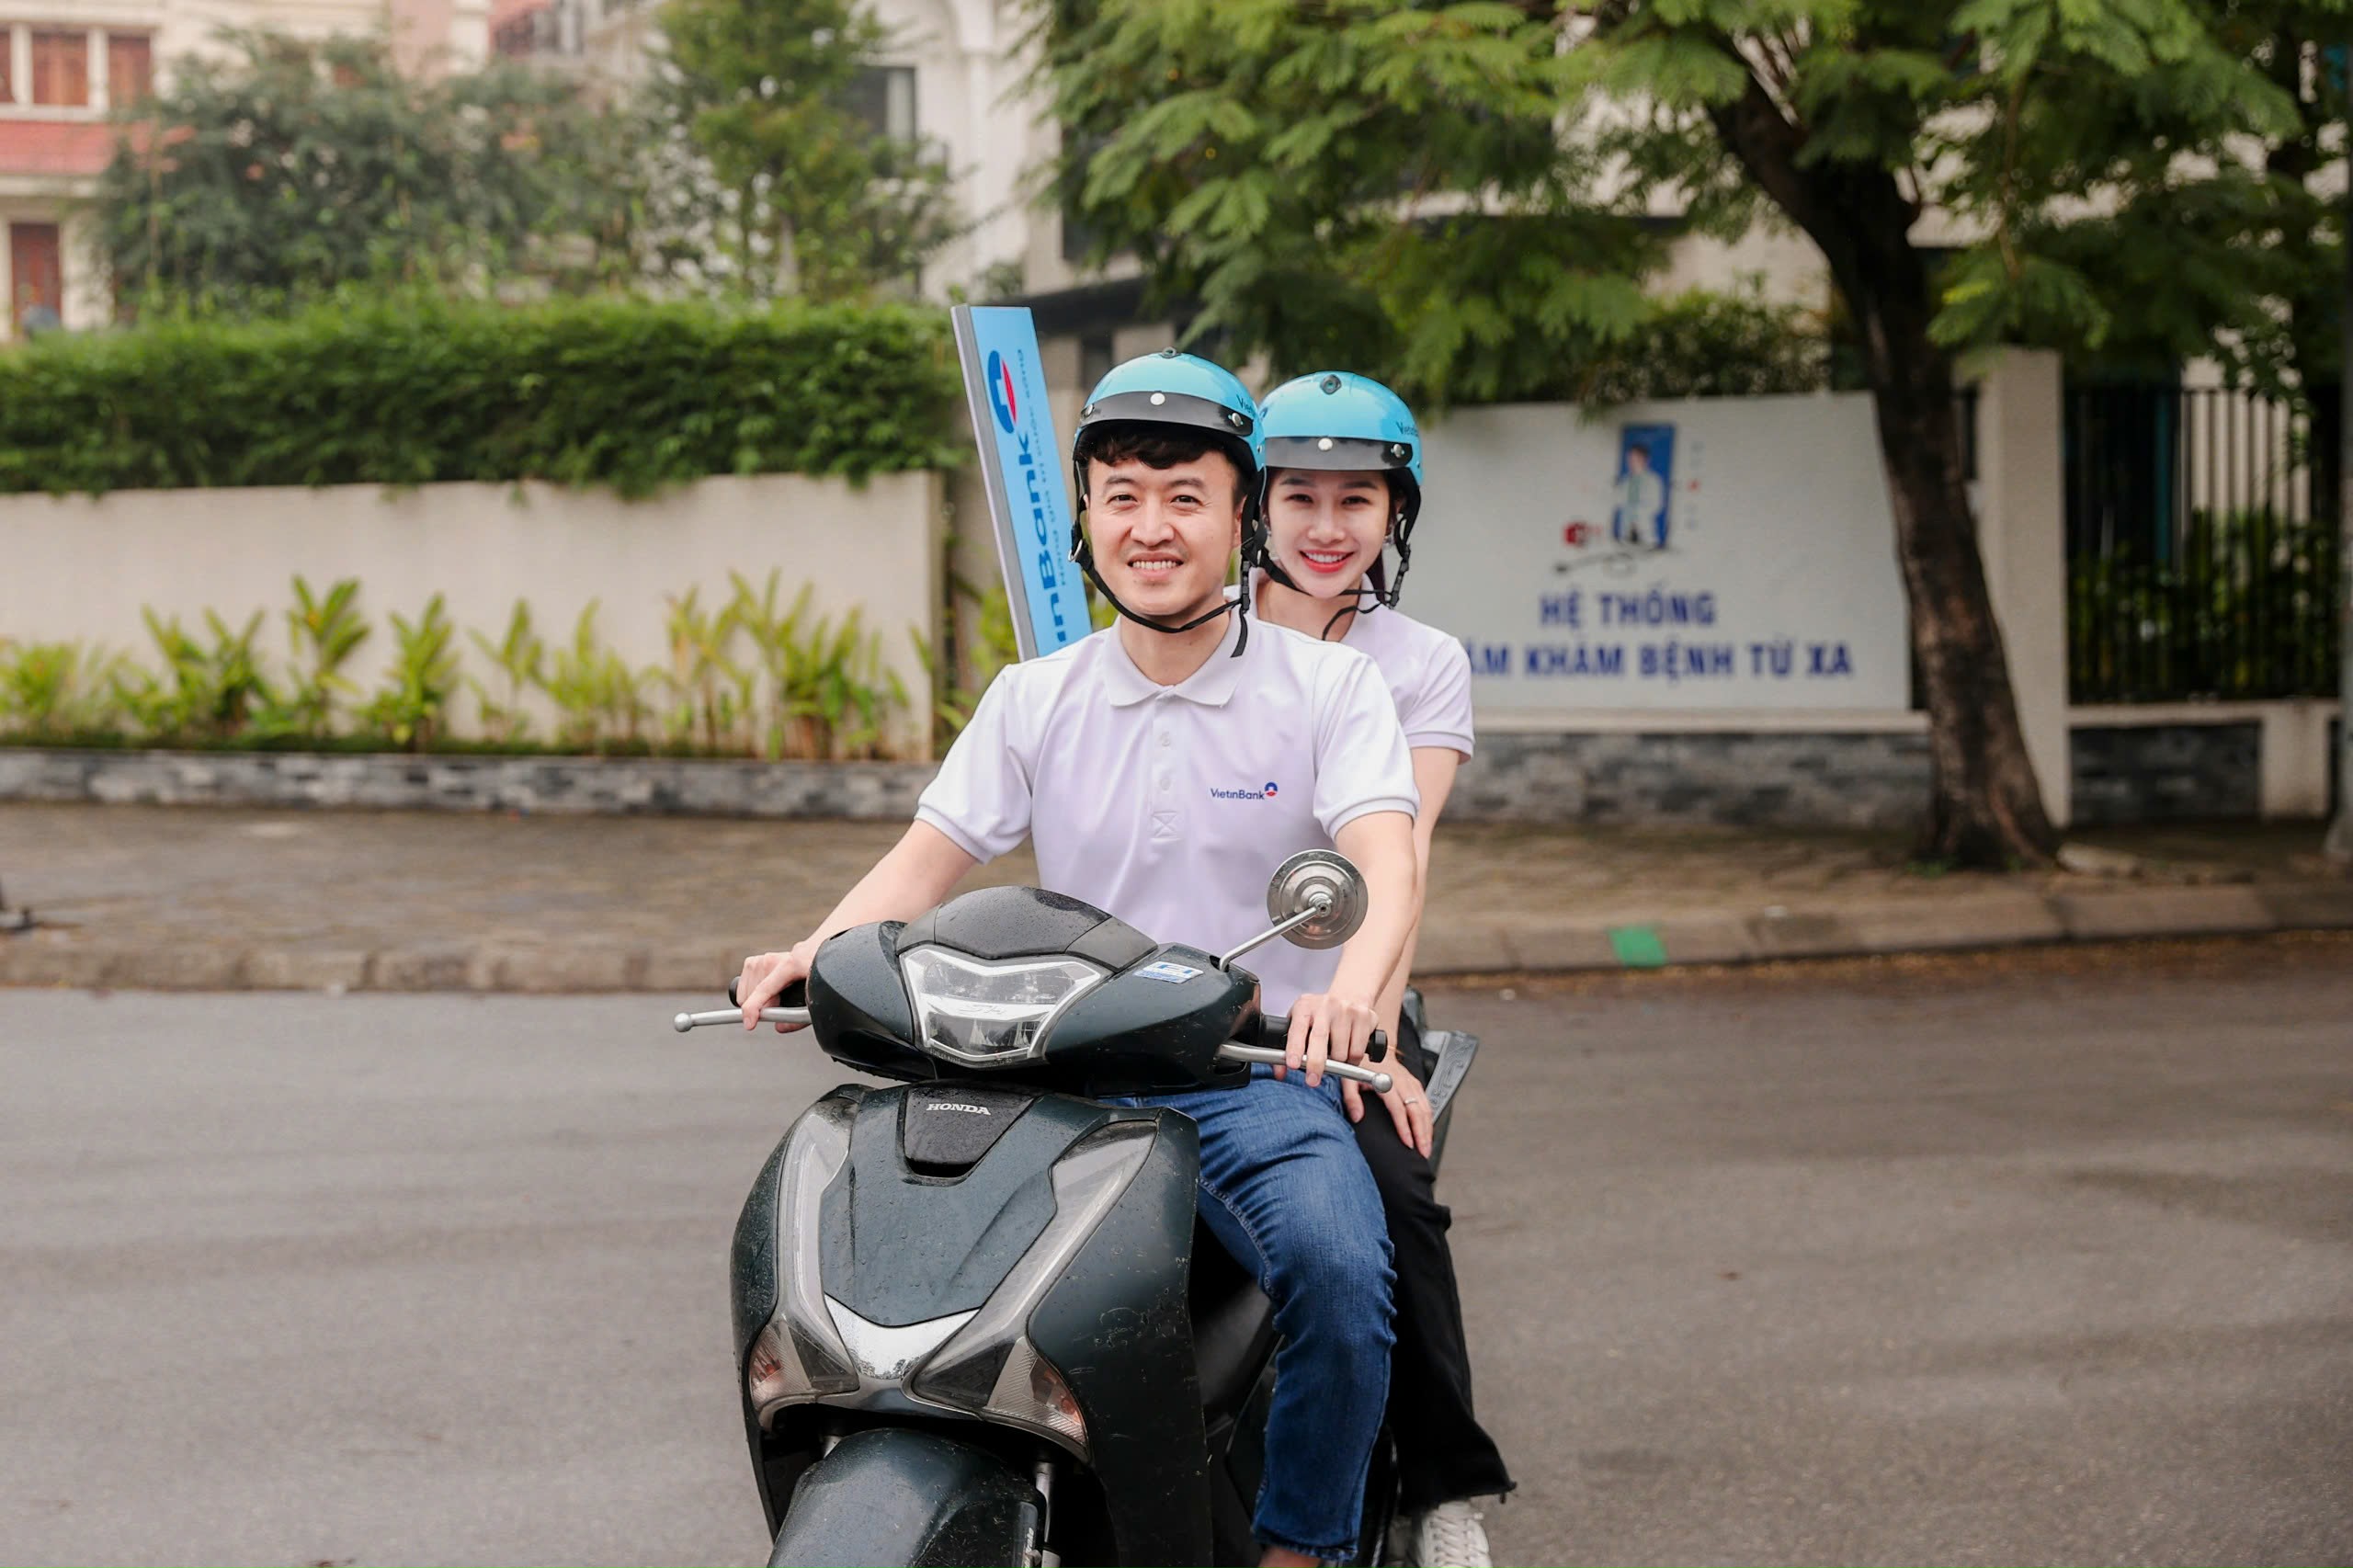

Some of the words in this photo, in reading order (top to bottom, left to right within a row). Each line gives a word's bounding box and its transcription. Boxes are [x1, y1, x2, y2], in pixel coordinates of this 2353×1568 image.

[1017, 430, 1067, 642] inBank
[1539, 588, 1582, 631] HỆ
[1597, 580, 1717, 629] THỐNG
[1524, 634, 1625, 676] KHÁM
[1639, 632, 1736, 686] BỆNH
[1748, 631, 1792, 676] TỪ
[1805, 643, 1854, 676] XA
[1210, 788, 1265, 800] VietinBank
[926, 1103, 992, 1116] HONDA
